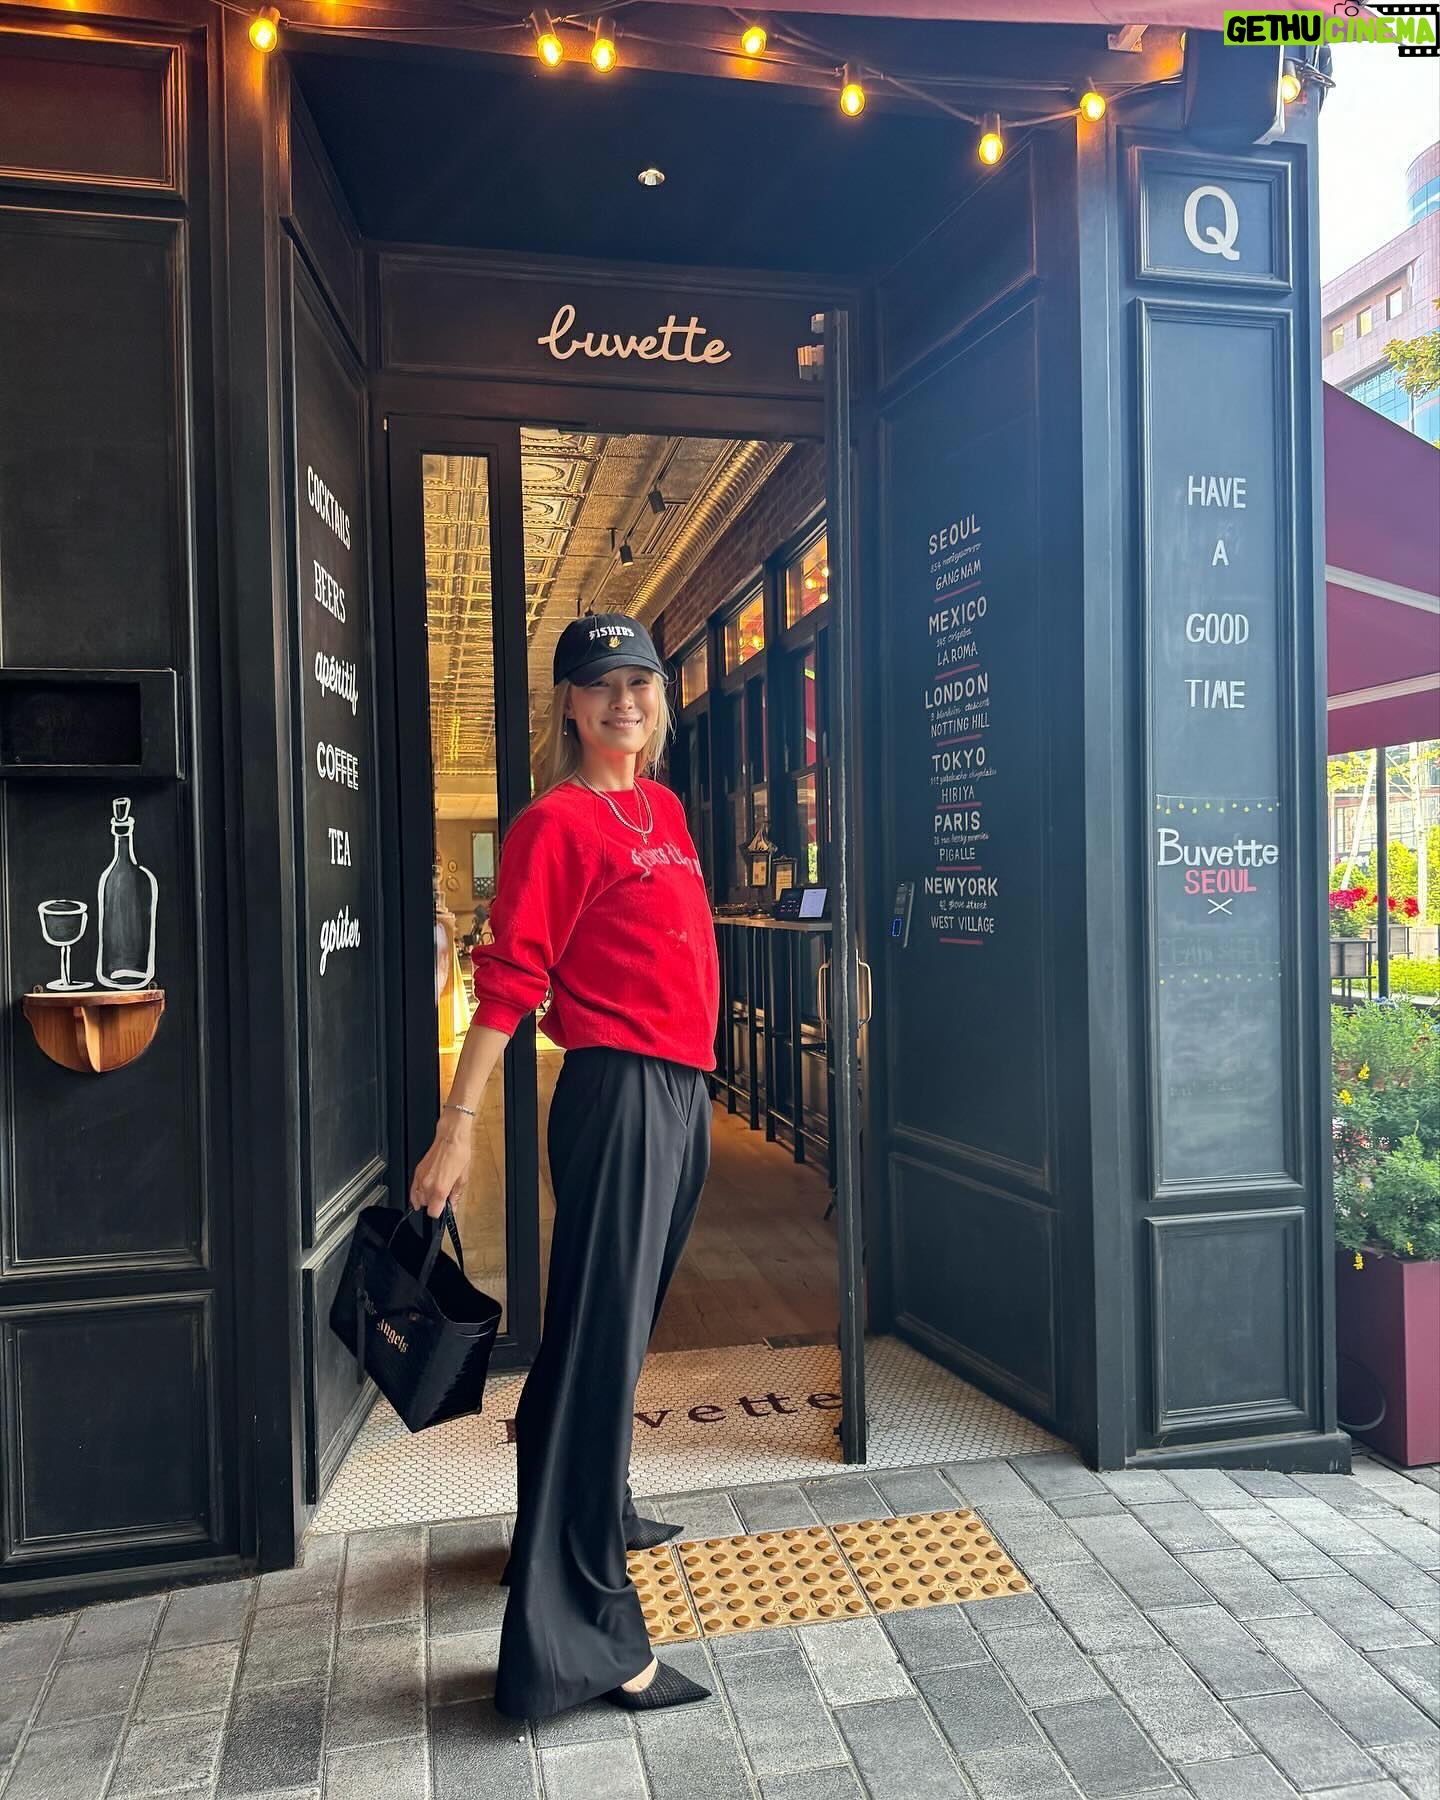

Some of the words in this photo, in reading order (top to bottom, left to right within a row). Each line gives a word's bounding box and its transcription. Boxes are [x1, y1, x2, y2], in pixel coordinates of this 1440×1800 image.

[1184, 185, 1240, 261] Q
[537, 304, 732, 364] buvette
[307, 465, 351, 551] COCKTAILS
[1187, 475, 1247, 509] HAVE
[928, 514, 982, 556] SEOUL
[1212, 539, 1230, 567] A
[313, 559, 346, 624] BEERS
[928, 596, 987, 636] MEXICO
[1185, 613, 1249, 645] GOOD
[588, 626, 635, 641] FISHERS
[937, 651, 950, 667] LA
[951, 641, 979, 662] ROMA
[925, 672, 989, 710] LONDON
[1184, 679, 1246, 709] TIME
[930, 717, 969, 739] NOTTING
[971, 712, 990, 730] HILL
[316, 741, 359, 791] COFFEE
[931, 747, 986, 773] TOKYO
[941, 785, 975, 804] HIBIYA
[934, 811, 981, 833] PARIS
[328, 827, 351, 867] TEA
[939, 847, 976, 862] PIGALLE
[1157, 828, 1279, 867] Buvette
[1184, 869, 1257, 895] SEOUL
[930, 914, 955, 929] WEST
[957, 916, 995, 934] VILLAGE
